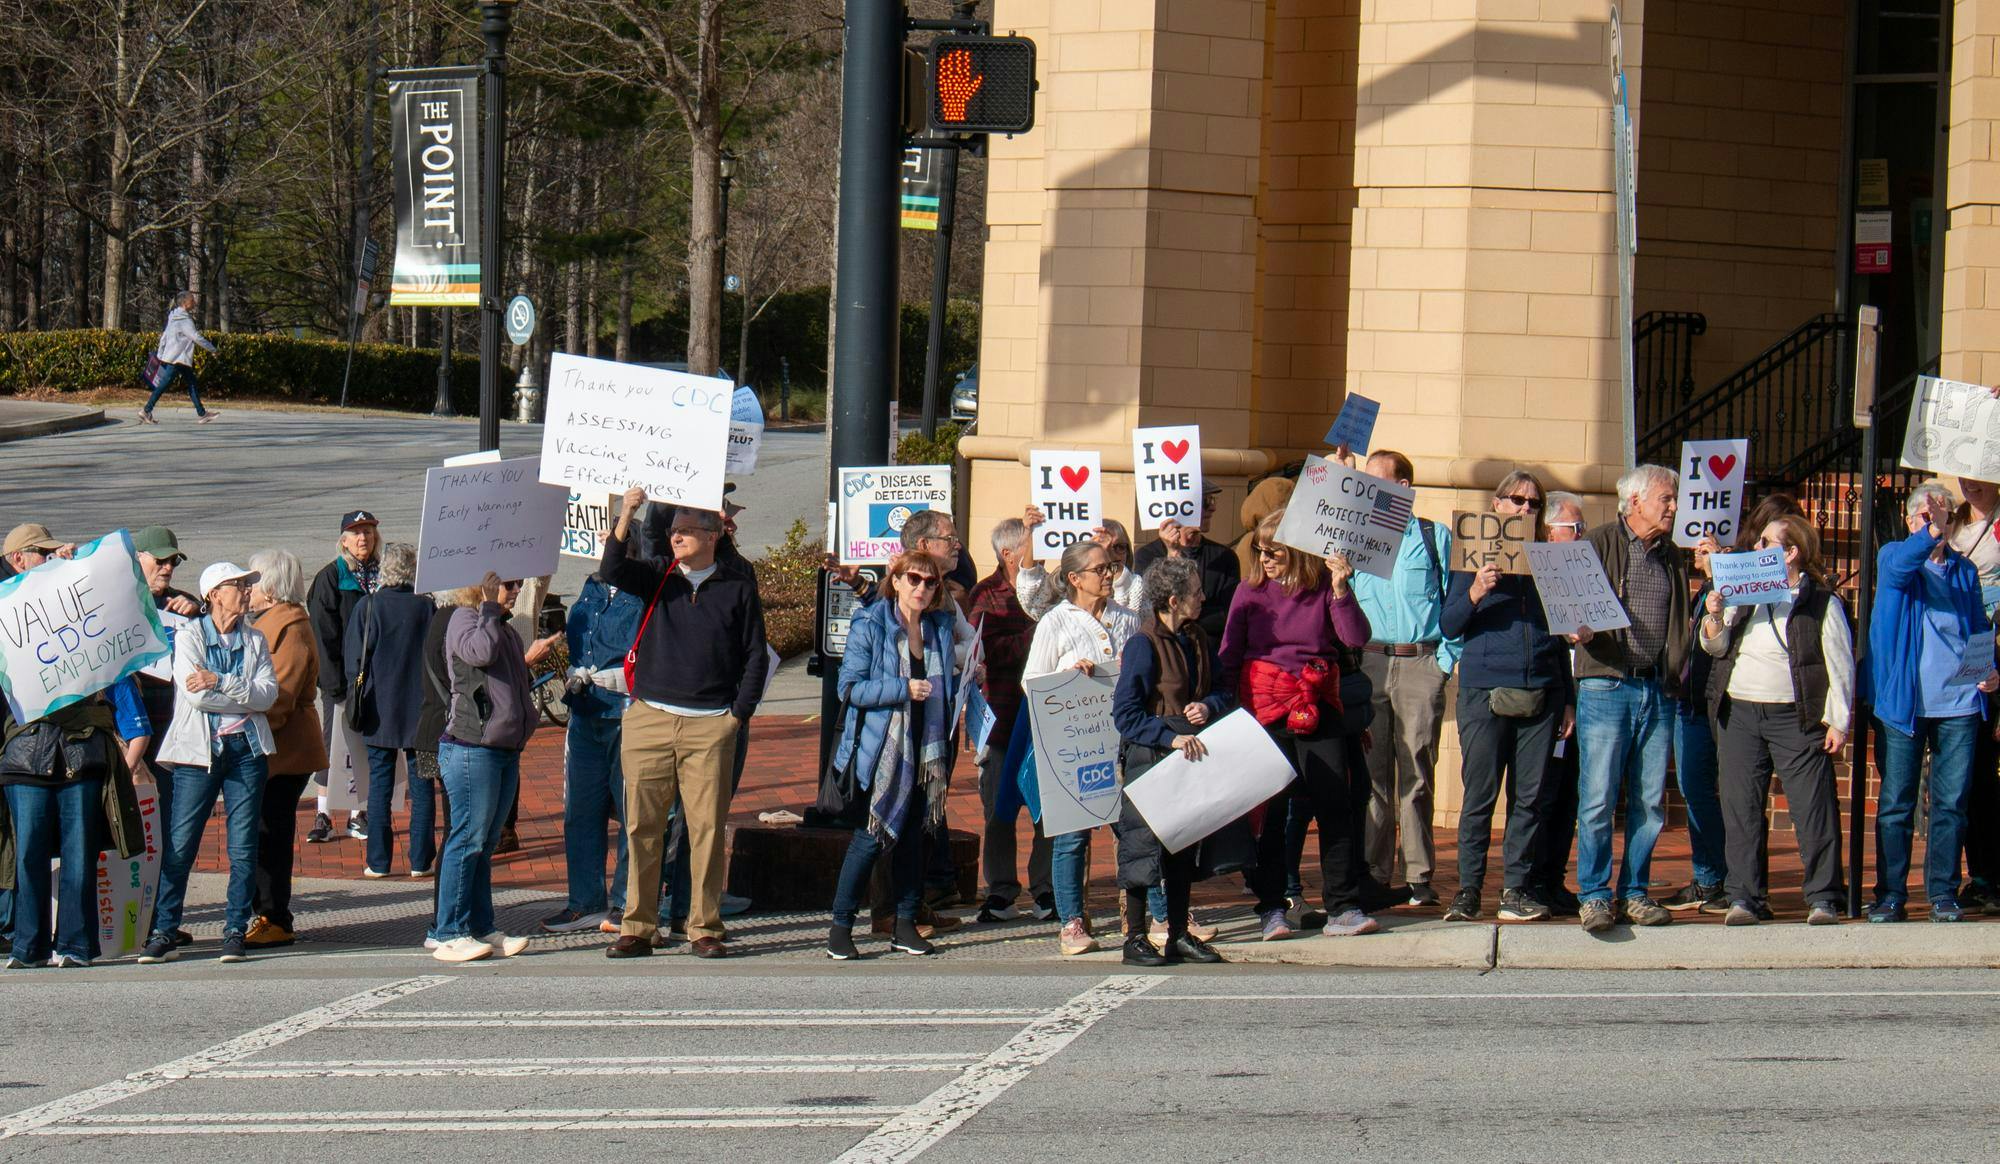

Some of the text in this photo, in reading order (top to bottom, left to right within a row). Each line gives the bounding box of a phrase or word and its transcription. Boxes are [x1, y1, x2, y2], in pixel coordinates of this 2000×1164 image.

[420, 101, 449, 120] THE
[420, 122, 455, 234] POINT
[563, 369, 725, 413] Thank you CDC
[567, 411, 672, 439] ASSESSING
[729, 434, 753, 445] FLU?
[556, 437, 700, 481] Vaccine Safety
[1142, 442, 1155, 464] I
[440, 467, 525, 491] THANK YOU
[1040, 466, 1053, 489] I
[1306, 464, 1329, 477] THANK
[1689, 456, 1701, 480] I
[844, 473, 932, 498] CDC DISEASE
[1146, 473, 1190, 492] THE
[1341, 476, 1376, 500] CDC
[875, 490, 947, 501] DETECTIVES
[1689, 490, 1731, 510] THE
[438, 504, 470, 522] Early
[565, 503, 607, 531] EALTH
[1043, 502, 1089, 520] THE
[1148, 500, 1194, 518] CDC
[1315, 499, 1370, 526] PROTECTS
[477, 517, 492, 532] of
[1456, 513, 1525, 541] CDC
[1685, 519, 1731, 538] CDC
[428, 545, 478, 560] Disease
[850, 540, 904, 558] HELP SAV
[1364, 536, 1393, 556] HEALTH
[1489, 540, 1503, 550] IS
[1462, 548, 1521, 571] KEY
[1530, 548, 1593, 571] CDC HAS
[1715, 562, 1739, 570] Thank
[1759, 555, 1777, 565] CDC
[1572, 574, 1606, 596] LIVES
[1725, 572, 1750, 582] helping
[1720, 579, 1789, 598] OUTBREAKS
[0, 575, 104, 649] VALUE
[1547, 600, 1619, 624] FOR 75 YEARS
[36, 614, 107, 665] CDC
[39, 623, 147, 694] EMPLOYEES
[1068, 710, 1104, 722] is our
[1063, 720, 1111, 738] Shield!!
[1057, 741, 1105, 763] Stand
[1082, 766, 1112, 784] CDC
[139, 797, 158, 862] Hands
